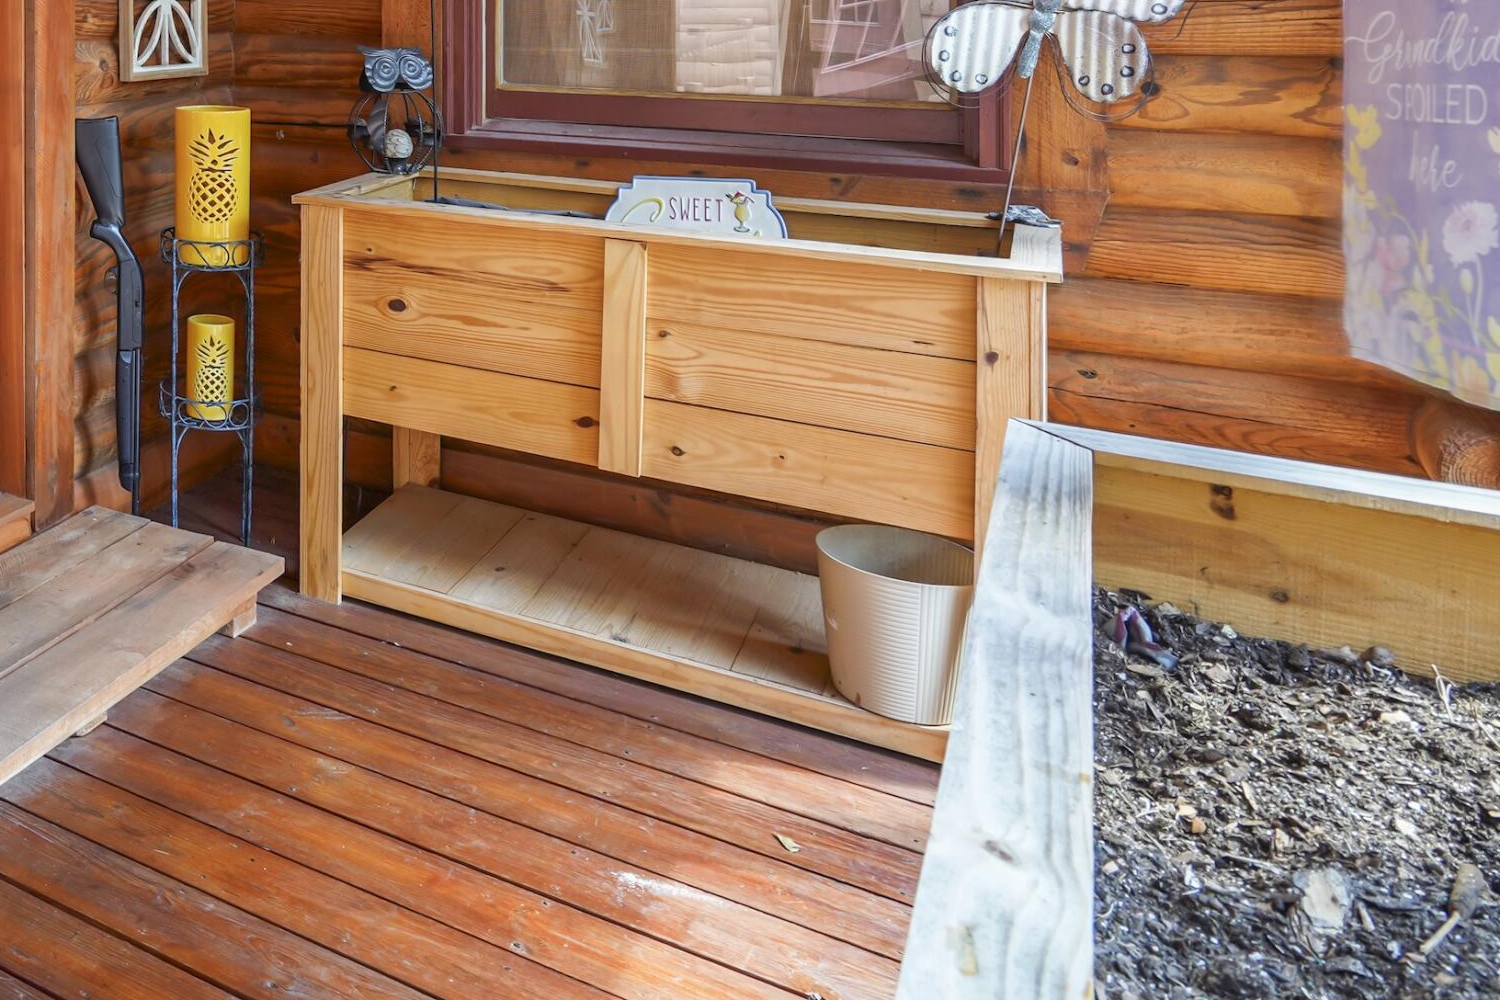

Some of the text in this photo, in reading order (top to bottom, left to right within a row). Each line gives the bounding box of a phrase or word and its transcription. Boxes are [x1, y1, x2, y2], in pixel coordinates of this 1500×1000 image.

[1384, 82, 1489, 126] SPOILED
[1408, 129, 1464, 193] here
[668, 196, 724, 223] SWEET
